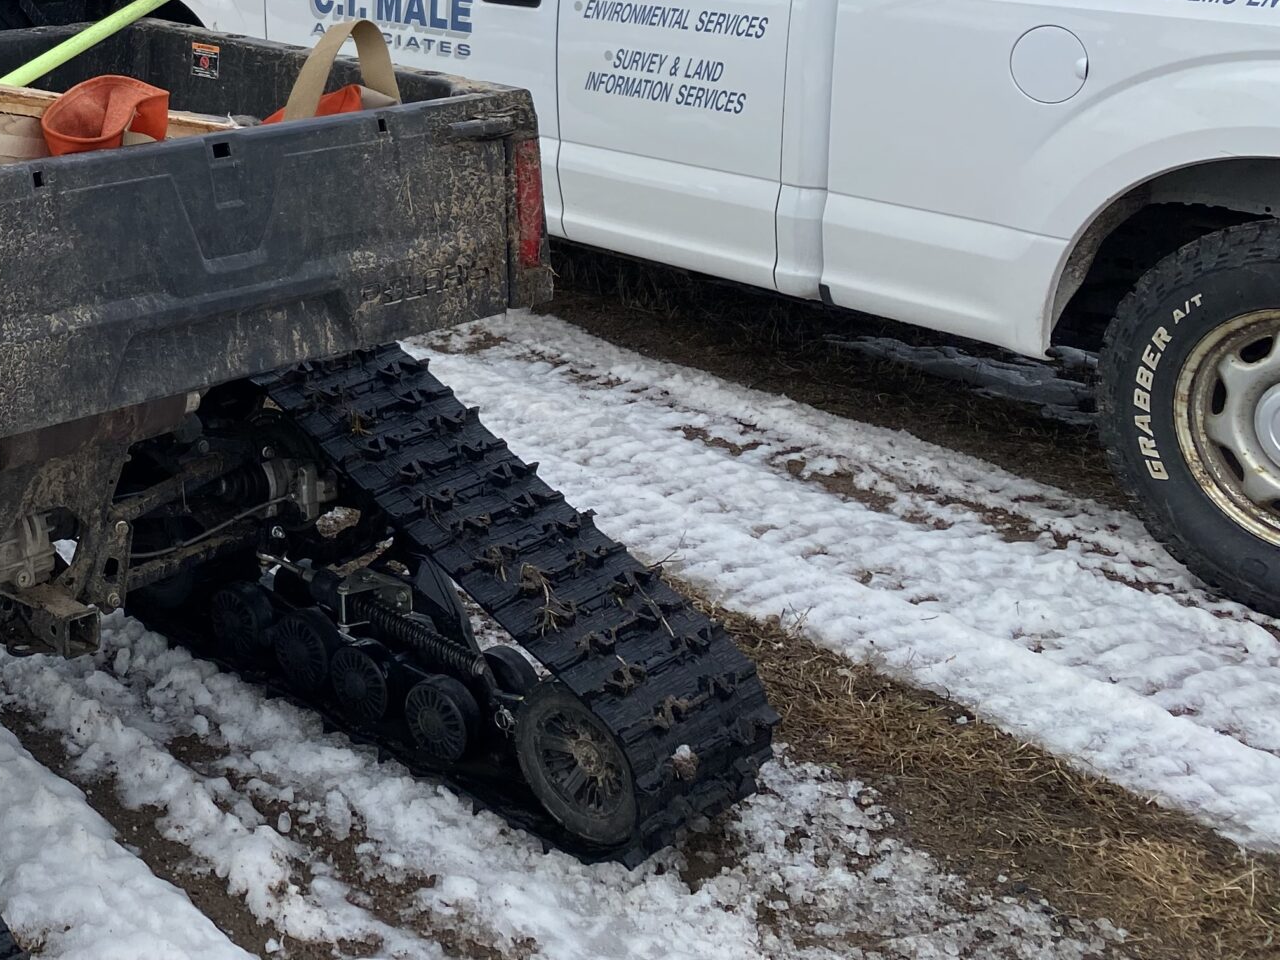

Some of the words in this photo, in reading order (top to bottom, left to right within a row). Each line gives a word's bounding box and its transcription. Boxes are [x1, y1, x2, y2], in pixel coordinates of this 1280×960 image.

[584, 0, 690, 30] ENVIRONMENTAL
[695, 10, 769, 39] SERVICES
[613, 48, 669, 75] SURVEY
[669, 56, 681, 77] &
[684, 58, 725, 82] LAND
[585, 71, 674, 103] INFORMATION
[675, 84, 747, 114] SERVICES
[1133, 326, 1172, 480] GRABBER
[1172, 293, 1202, 324] A/T
